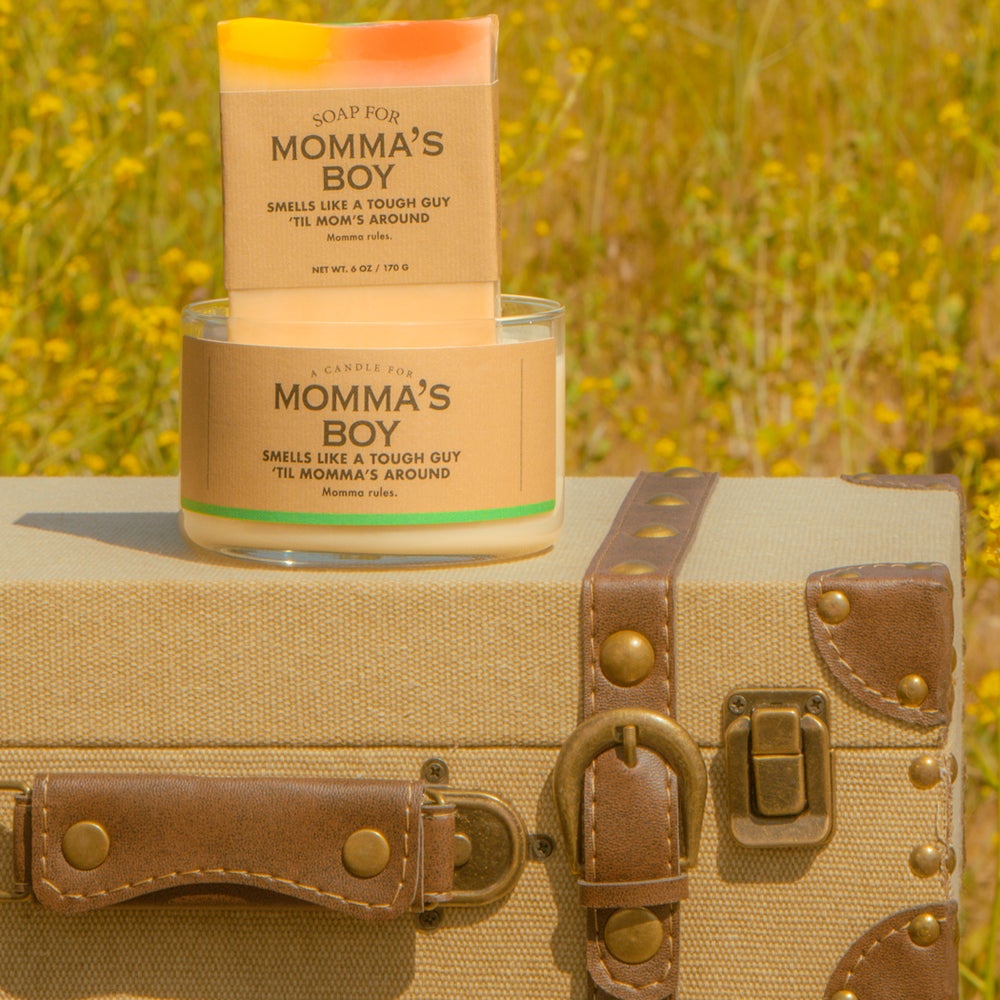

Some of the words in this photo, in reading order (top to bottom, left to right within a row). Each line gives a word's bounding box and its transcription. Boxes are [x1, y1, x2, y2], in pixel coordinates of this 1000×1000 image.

[313, 106, 359, 127] SOAP
[365, 106, 399, 125] FOR
[272, 126, 443, 161] MOMMA'S
[322, 164, 395, 191] BOY
[267, 201, 315, 212] SMELLS
[321, 200, 347, 210] LIKE
[353, 200, 362, 209] A
[367, 198, 416, 209] TOUGH
[421, 197, 450, 208] GUY
[289, 216, 311, 227] 'TIL
[316, 215, 364, 226] MOM'S
[369, 213, 429, 224] AROUND
[367, 232, 392, 240] rules.
[375, 264, 380, 272] /
[324, 363, 379, 374] CANDLE
[388, 366, 413, 378] FOR
[274, 379, 450, 412] MOMMA'S
[322, 420, 400, 447] BOY
[262, 450, 311, 463] SMELLS
[318, 453, 347, 464] LIKE
[353, 453, 364, 464] A
[370, 453, 424, 464] TOUGH
[430, 451, 460, 463] GUY
[272, 467, 294, 478] 'TIL
[300, 468, 377, 480] MOMMA'S
[384, 468, 450, 480] AROUND
[322, 488, 363, 497] Momma
[369, 488, 397, 497] rules.
